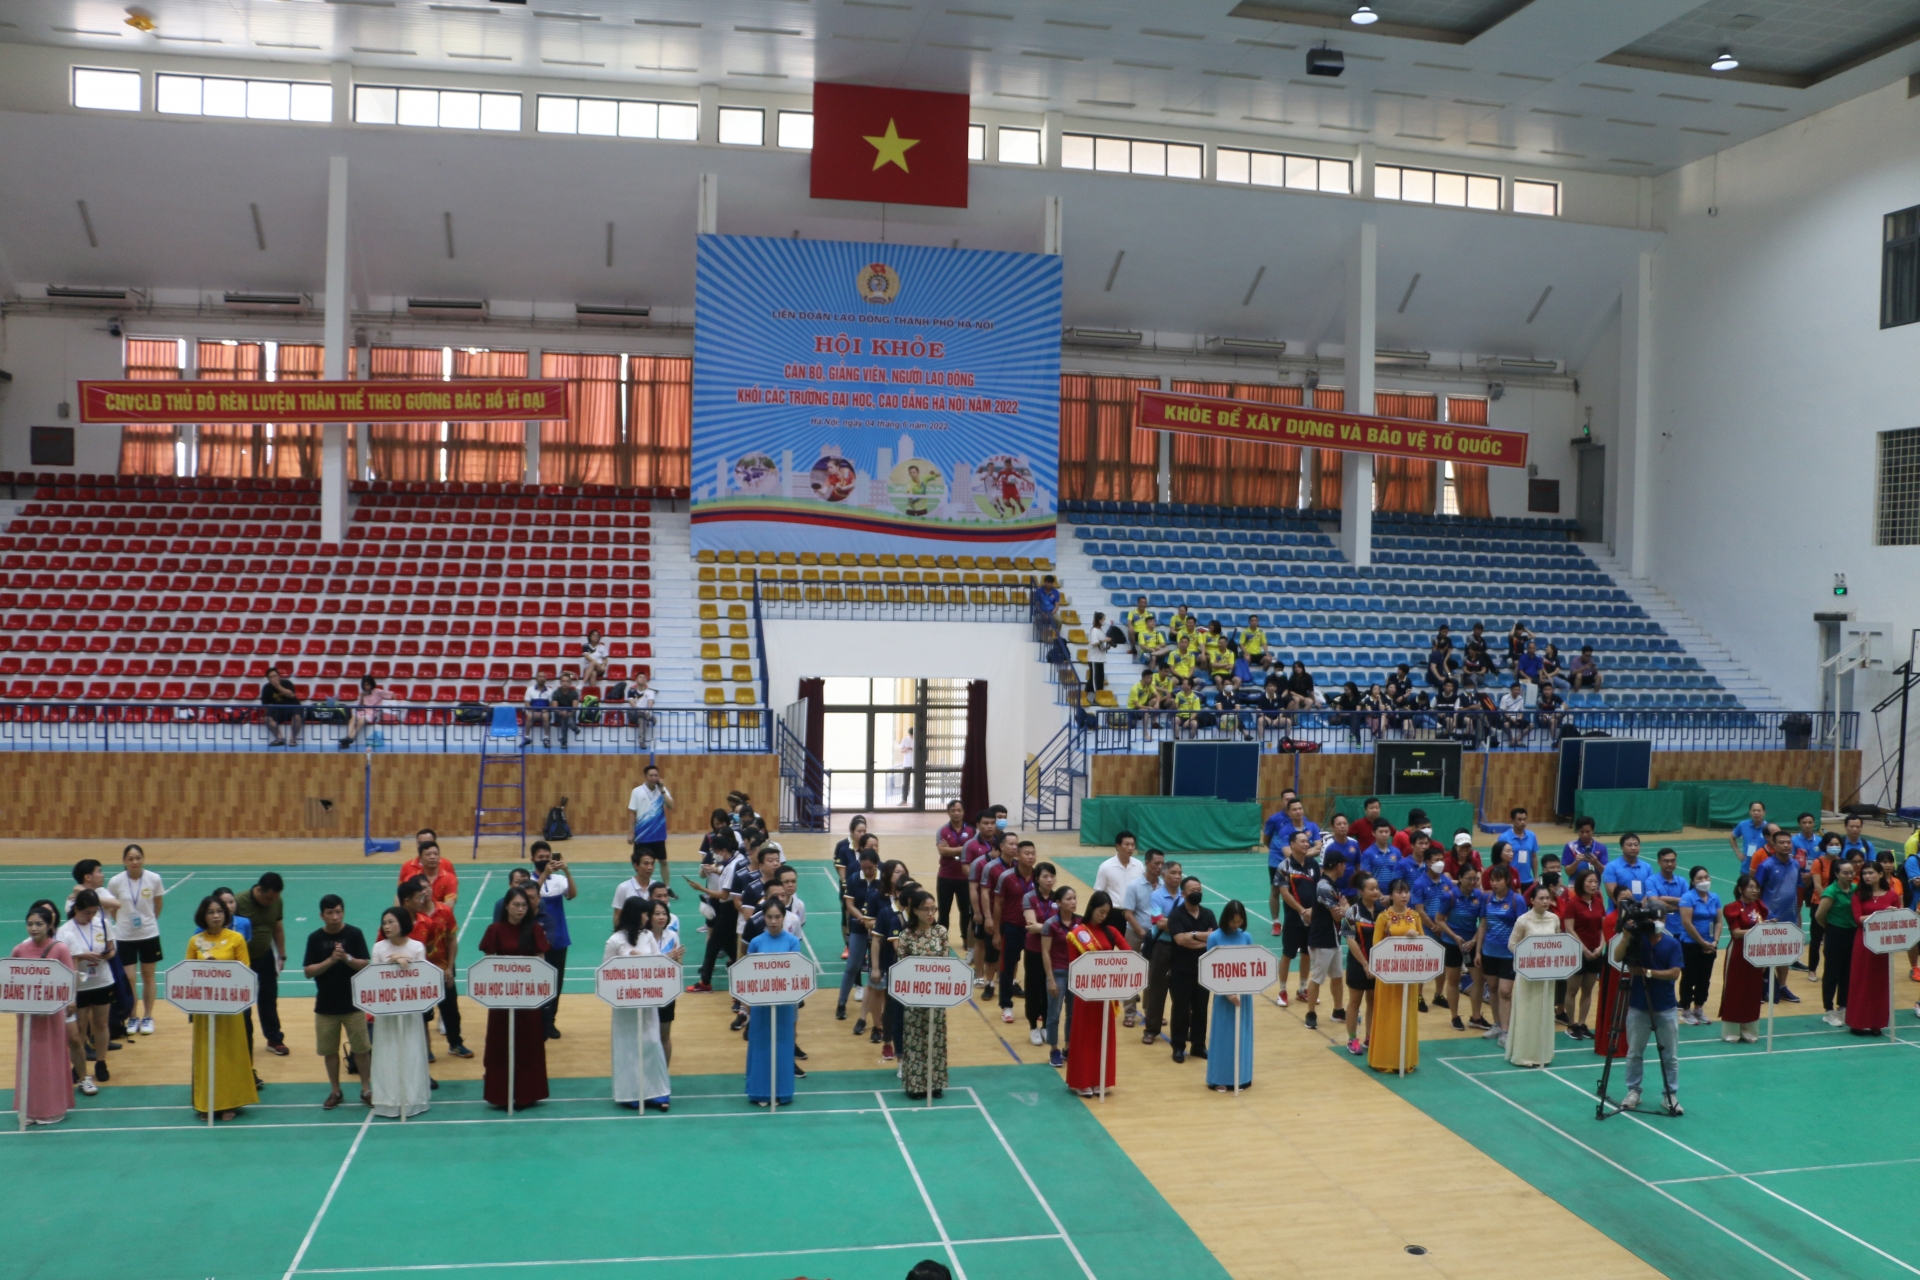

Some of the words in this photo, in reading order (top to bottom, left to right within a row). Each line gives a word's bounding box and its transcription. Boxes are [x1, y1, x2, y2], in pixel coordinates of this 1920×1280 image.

[813, 332, 862, 358] HỘI
[870, 334, 945, 358] KHỎE
[784, 361, 806, 379] CÁN
[828, 361, 860, 381] GIẢNG
[892, 366, 922, 384] NGƯỜI
[926, 371, 944, 386] LAO
[947, 370, 974, 389] ĐỘNG
[166, 388, 192, 410] THỦ
[196, 390, 216, 410] ĐÔ
[220, 390, 248, 410] RÈN
[252, 391, 296, 414] LUYỆN
[299, 390, 335, 410] THÂN
[339, 387, 365, 410] THỂ
[368, 393, 401, 410] THEO
[455, 390, 481, 409] BÁC
[486, 388, 503, 408] HỒ
[523, 392, 546, 412] ĐẠI
[737, 384, 762, 403] KHỐI
[765, 386, 785, 404] CÁC
[788, 387, 828, 406] TRƯỜNG
[832, 392, 848, 409] ĐẠI
[878, 394, 898, 408] CAO
[902, 388, 929, 410] ĐẲNG
[932, 394, 945, 410] HÀ
[948, 394, 965, 414] NỘI
[968, 396, 991, 412] NĂM
[994, 400, 1018, 414] 2022
[1164, 403, 1212, 424] KHỎE
[1217, 407, 1242, 428] ĐỂ
[1246, 413, 1281, 432] XÂY
[1286, 418, 1334, 438] DỰNG
[1340, 423, 1361, 441] VÀ
[1367, 424, 1402, 445] BẢO
[1408, 431, 1427, 450] VỆ
[1433, 431, 1454, 450] TỔ
[1458, 435, 1502, 456] QUỐC
[1762, 927, 1788, 936] TRƯỜNG
[1394, 942, 1424, 952] TRƯỜNG
[1533, 940, 1562, 949] TRƯỜNG
[10, 964, 50, 976] TRƯỜNG
[493, 962, 531, 972] TRƯỜNG
[754, 959, 790, 970] TRƯỜNG
[914, 962, 950, 972] TRƯỜNG
[1094, 956, 1128, 966] TRƯỜNG
[1212, 962, 1246, 981] TRỌNG
[1250, 958, 1266, 976] TÀI
[192, 967, 232, 978] TRƯỜNG
[602, 966, 626, 980] TRƯỜNG
[628, 965, 639, 980] ĐÀO
[641, 968, 652, 981] TẠO
[654, 966, 666, 978] CÁN
[668, 965, 676, 980] BỘ
[4, 976, 24, 1000] ĐẲNG
[27, 985, 31, 1000] Y
[34, 979, 42, 1000] TẾ
[44, 982, 54, 1000] HÀ
[57, 982, 70, 1004] NỘI
[474, 982, 486, 998] ĐẠI
[489, 982, 503, 998] HỌC
[506, 980, 523, 998] LUẬT
[526, 980, 536, 996] HÀ
[538, 980, 550, 998] NỘI
[736, 980, 746, 996] ĐẠI
[748, 980, 758, 995] HỌC
[760, 979, 770, 992] LAO
[771, 976, 786, 994] ĐỘNG
[801, 974, 810, 992] HỘI
[894, 980, 910, 996] ĐẠI
[913, 981, 931, 997] HỌC
[935, 976, 952, 995] THỦ
[954, 980, 966, 996] ĐÔ
[1076, 974, 1088, 992] ĐẠI
[1091, 974, 1106, 991] HỌC
[1130, 972, 1142, 990] LỢI
[361, 990, 376, 1006] ĐẠI
[379, 988, 396, 1005] HỌC
[400, 984, 417, 1000] VĂN
[420, 982, 438, 999] HÓA
[617, 986, 624, 1000] LÊ
[625, 984, 642, 999] HỒNG
[643, 987, 663, 998] PHONG
